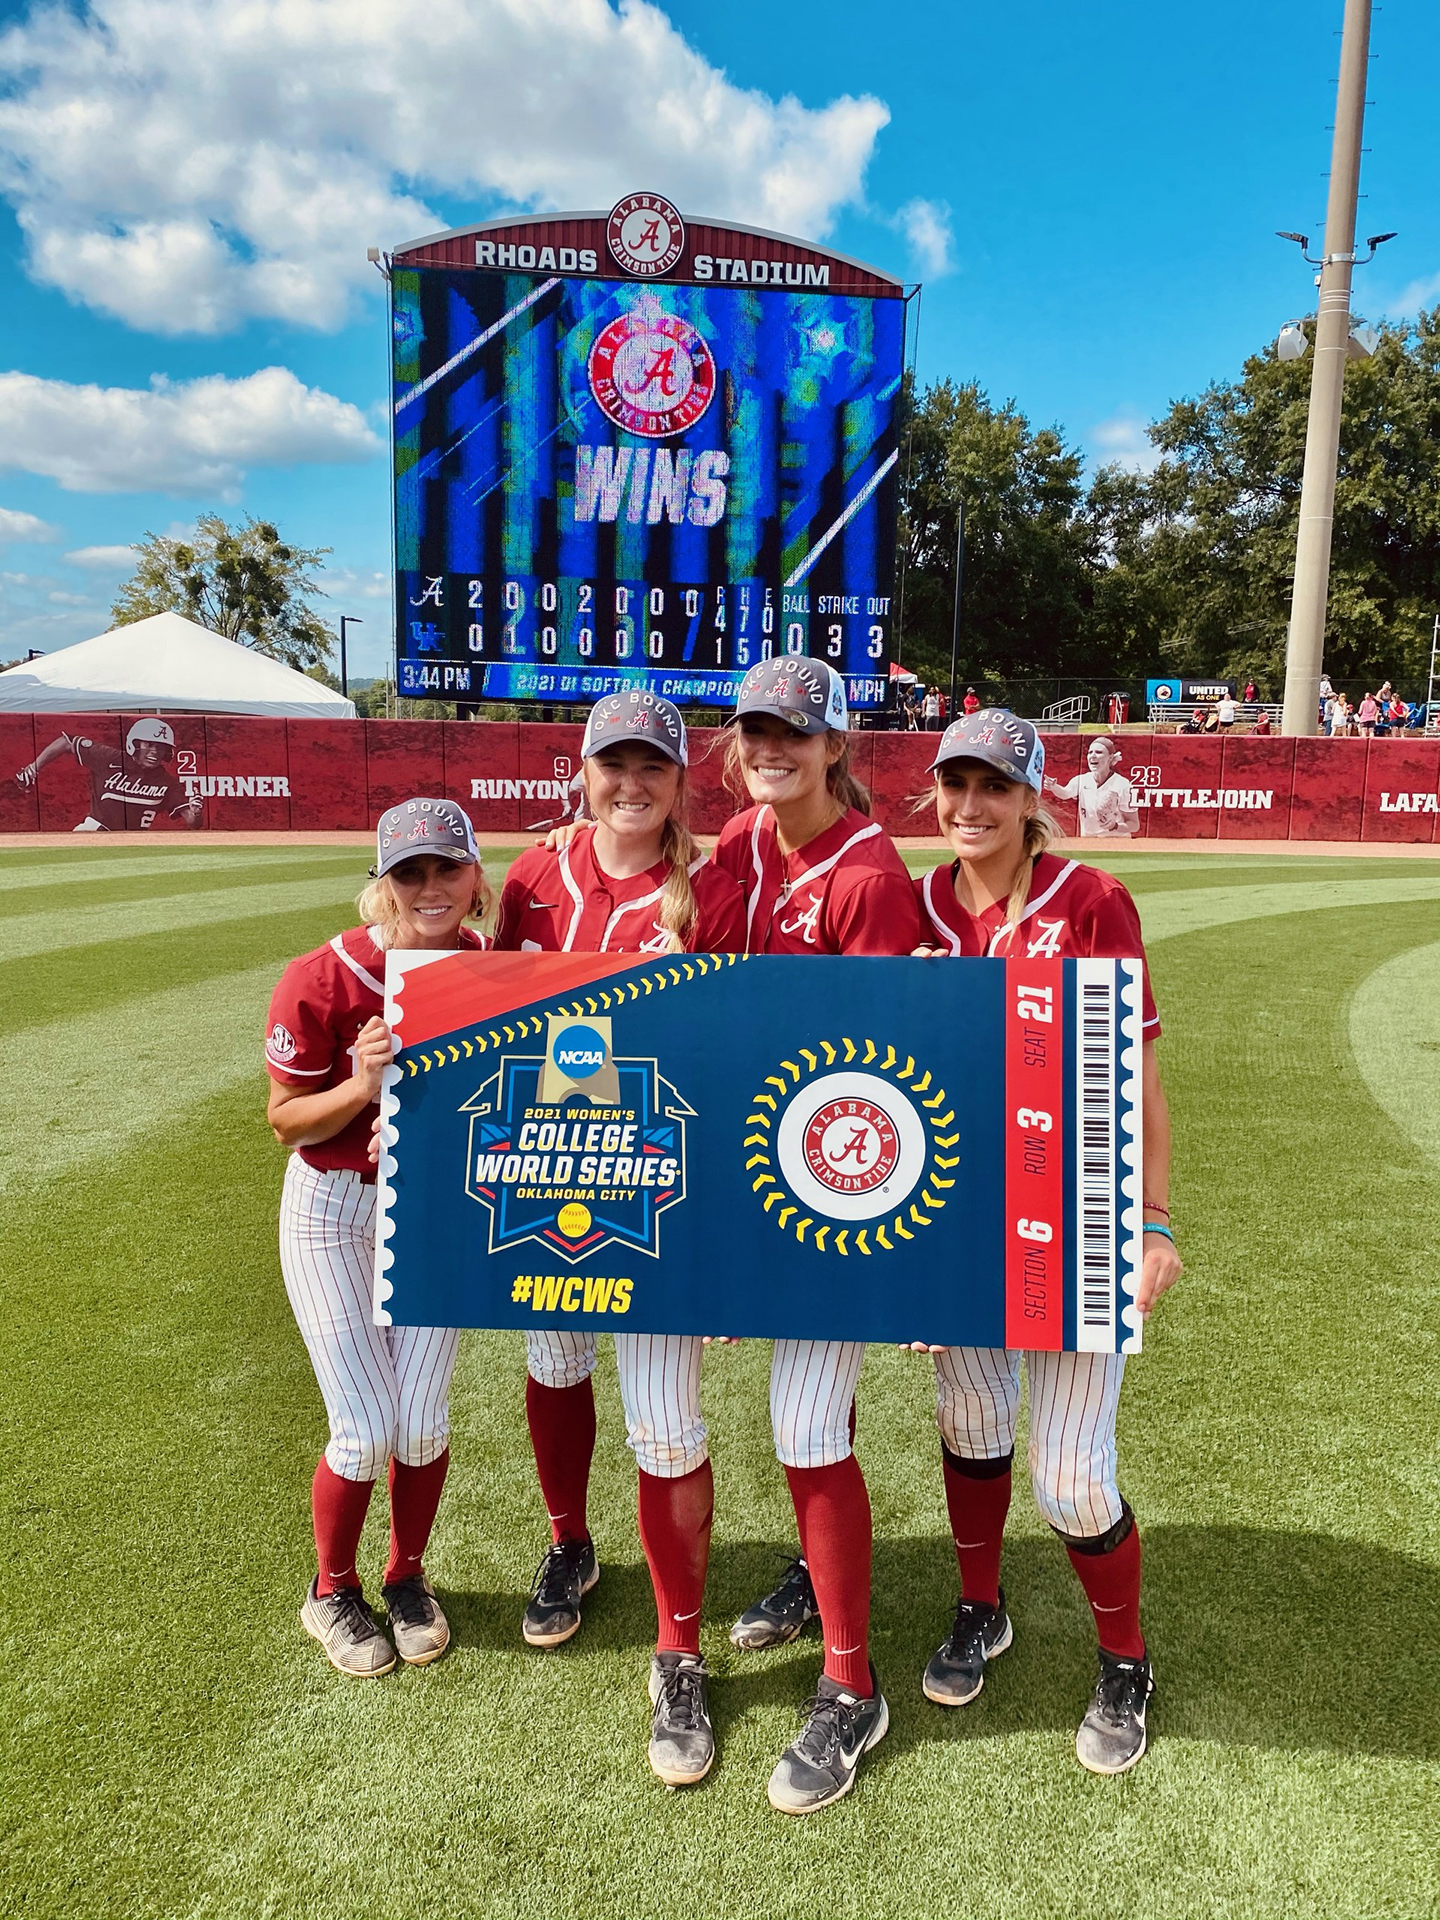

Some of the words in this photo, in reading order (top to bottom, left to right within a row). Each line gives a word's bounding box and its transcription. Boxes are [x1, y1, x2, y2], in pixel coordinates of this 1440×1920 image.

[612, 197, 681, 234] ALABAMA
[628, 218, 660, 252] A
[475, 240, 598, 272] RHOADS
[611, 237, 656, 273] CRIMSON
[657, 243, 680, 270] TIDE
[694, 254, 830, 286] STADIUM
[595, 378, 673, 432] CRIMSON
[574, 444, 731, 527] WINS
[468, 579, 483, 609] 2
[541, 582, 557, 612] 0
[577, 584, 593, 613] 2
[615, 586, 628, 615] 0
[650, 587, 665, 616] 0
[685, 589, 699, 618] 0
[782, 594, 811, 613] BALL
[818, 595, 860, 615] STRIKE
[867, 597, 891, 616] OUT
[714, 605, 726, 632] 4
[740, 605, 750, 632] 7
[762, 606, 774, 634] 0
[468, 624, 483, 652] 0
[541, 627, 557, 655] 0
[579, 628, 593, 656] 0
[615, 629, 628, 657] 0
[650, 630, 664, 659] 0
[715, 637, 723, 664] 1
[737, 637, 750, 665] 5
[787, 622, 804, 656] 0
[827, 624, 843, 657] 3
[867, 625, 884, 658] 3
[403, 665, 441, 690] 3:44
[444, 667, 471, 691] PM
[516, 673, 555, 691] 2021
[581, 676, 656, 694] SOFTBALL
[741, 666, 765, 700] OKC
[772, 659, 824, 704] BOUND
[850, 679, 886, 703] MPH
[1189, 685, 1229, 695] UNITED
[594, 699, 621, 731] OKC
[629, 693, 678, 738] BOUND
[942, 718, 969, 749] OKC
[978, 710, 1027, 757] BOUND
[177, 750, 197, 774] 2
[553, 756, 571, 779] 9
[1130, 766, 1161, 787] 28
[104, 771, 169, 798] Alabama
[179, 776, 291, 797] TURNER
[470, 778, 570, 800] RUNYON
[1129, 788, 1274, 809] LITTLEJOHN
[1379, 792, 1440, 813] LAFA
[140, 810, 156, 828] 2
[382, 813, 401, 848] OKC
[407, 801, 464, 837] BOUND
[1017, 985, 1053, 1024] 21
[557, 1050, 604, 1065] NCAA
[1024, 1026, 1047, 1069] SEAT
[524, 1108, 561, 1120] 2021
[566, 1109, 636, 1121] WOMEN'S
[811, 1103, 893, 1143] ALABAMA
[1017, 1106, 1053, 1133] 3
[518, 1123, 638, 1153] COLLEGE
[829, 1126, 870, 1165] A
[475, 1154, 575, 1184] WORLD
[577, 1156, 678, 1187] SERIES
[809, 1148, 862, 1189] CRIMSON
[864, 1155, 892, 1185] TIDE
[1024, 1134, 1046, 1177] ROW
[516, 1187, 596, 1200] OKLAHOMA
[600, 1189, 636, 1201] CITY
[1017, 1217, 1053, 1244] 6
[511, 1275, 635, 1314] #WCWS
[1024, 1246, 1047, 1321] SECTION
